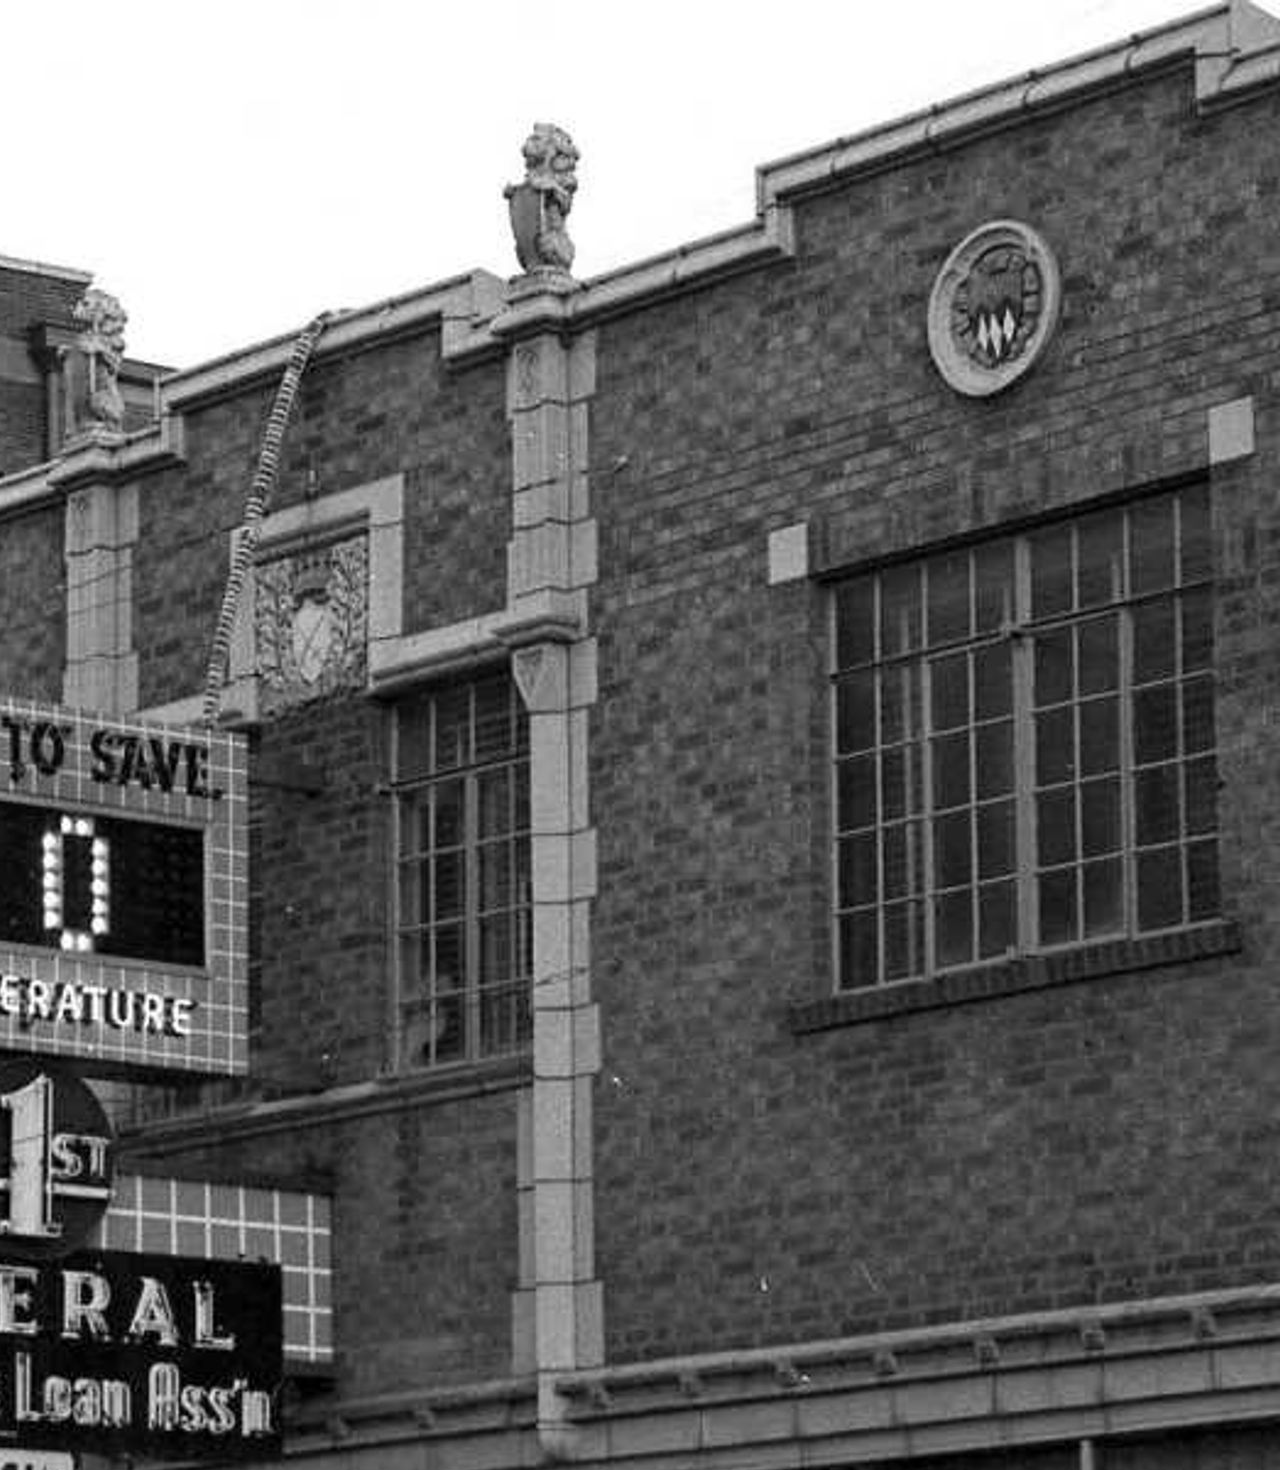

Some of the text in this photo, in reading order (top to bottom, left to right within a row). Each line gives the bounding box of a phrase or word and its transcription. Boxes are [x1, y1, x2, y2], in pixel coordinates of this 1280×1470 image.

[1, 716, 72, 783] TO
[90, 730, 224, 800] SAVE
[42, 814, 111, 953] 0
[15, 1351, 132, 1427] Loan
[148, 1362, 273, 1437] Ass'n
